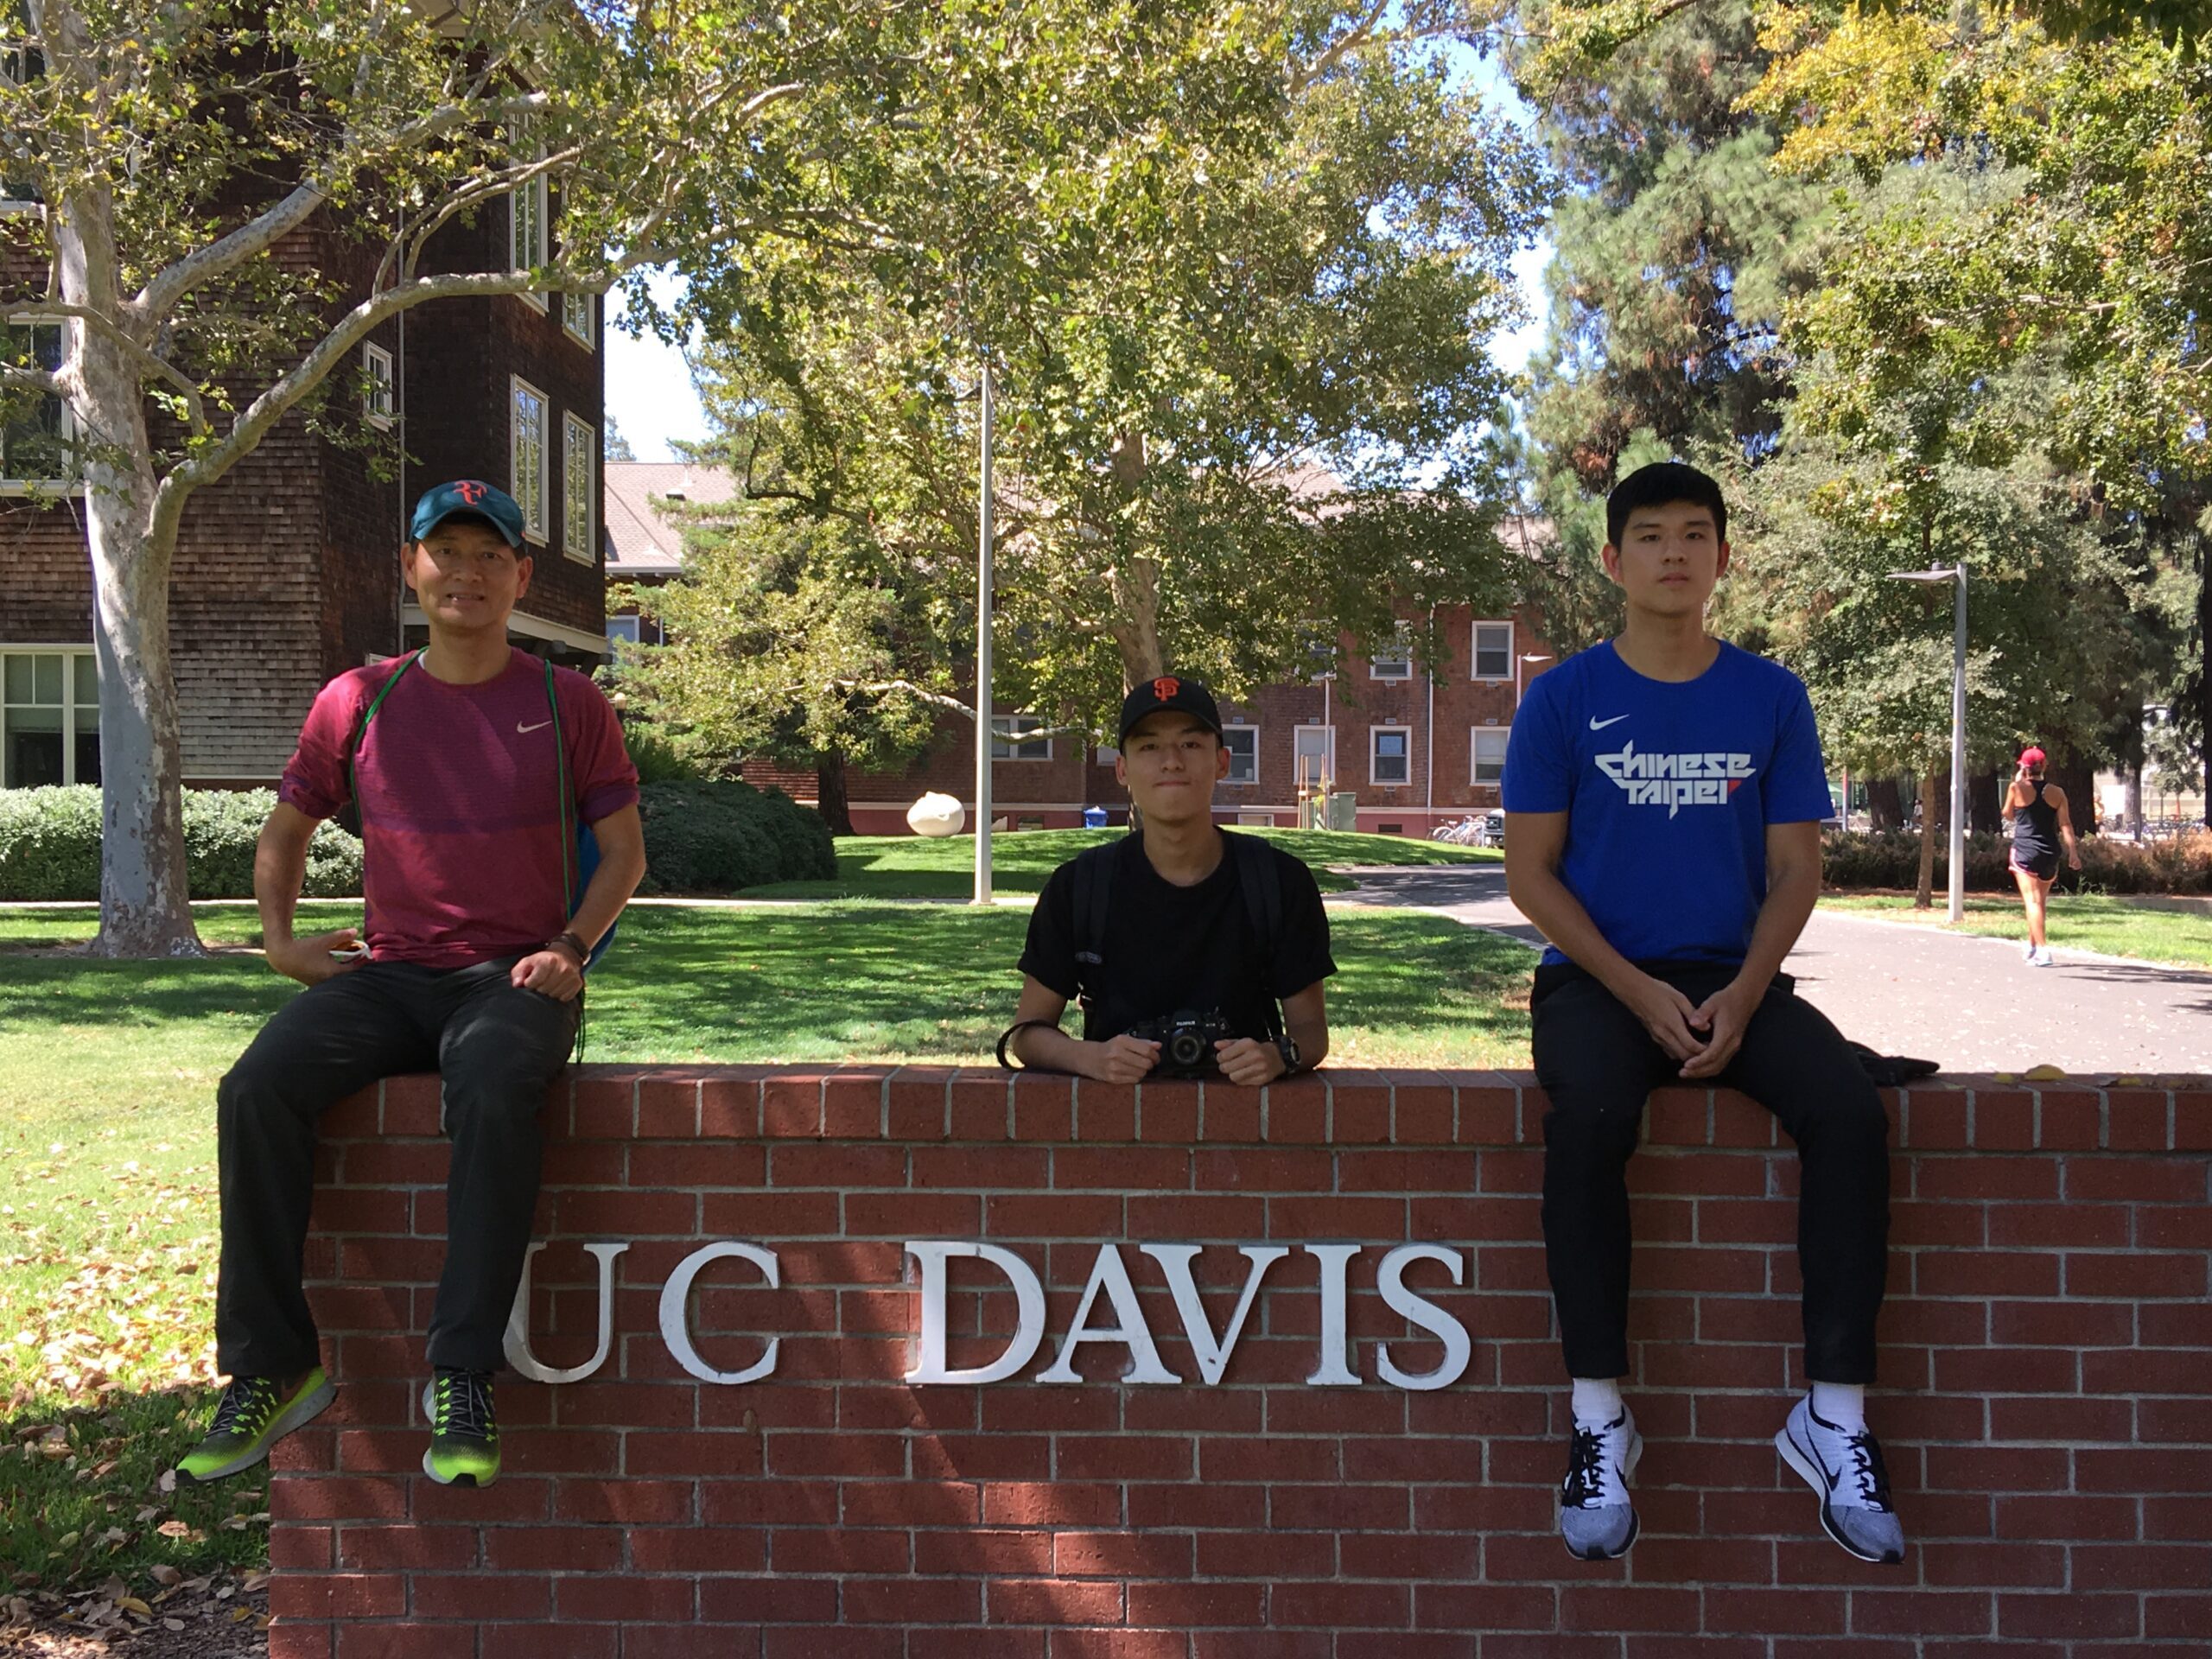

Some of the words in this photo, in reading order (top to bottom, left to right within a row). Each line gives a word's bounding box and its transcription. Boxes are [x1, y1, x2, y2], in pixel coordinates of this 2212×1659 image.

[1154, 677, 1180, 702] SF
[502, 1241, 780, 1384] UC
[904, 1241, 1471, 1392] DAVIS
